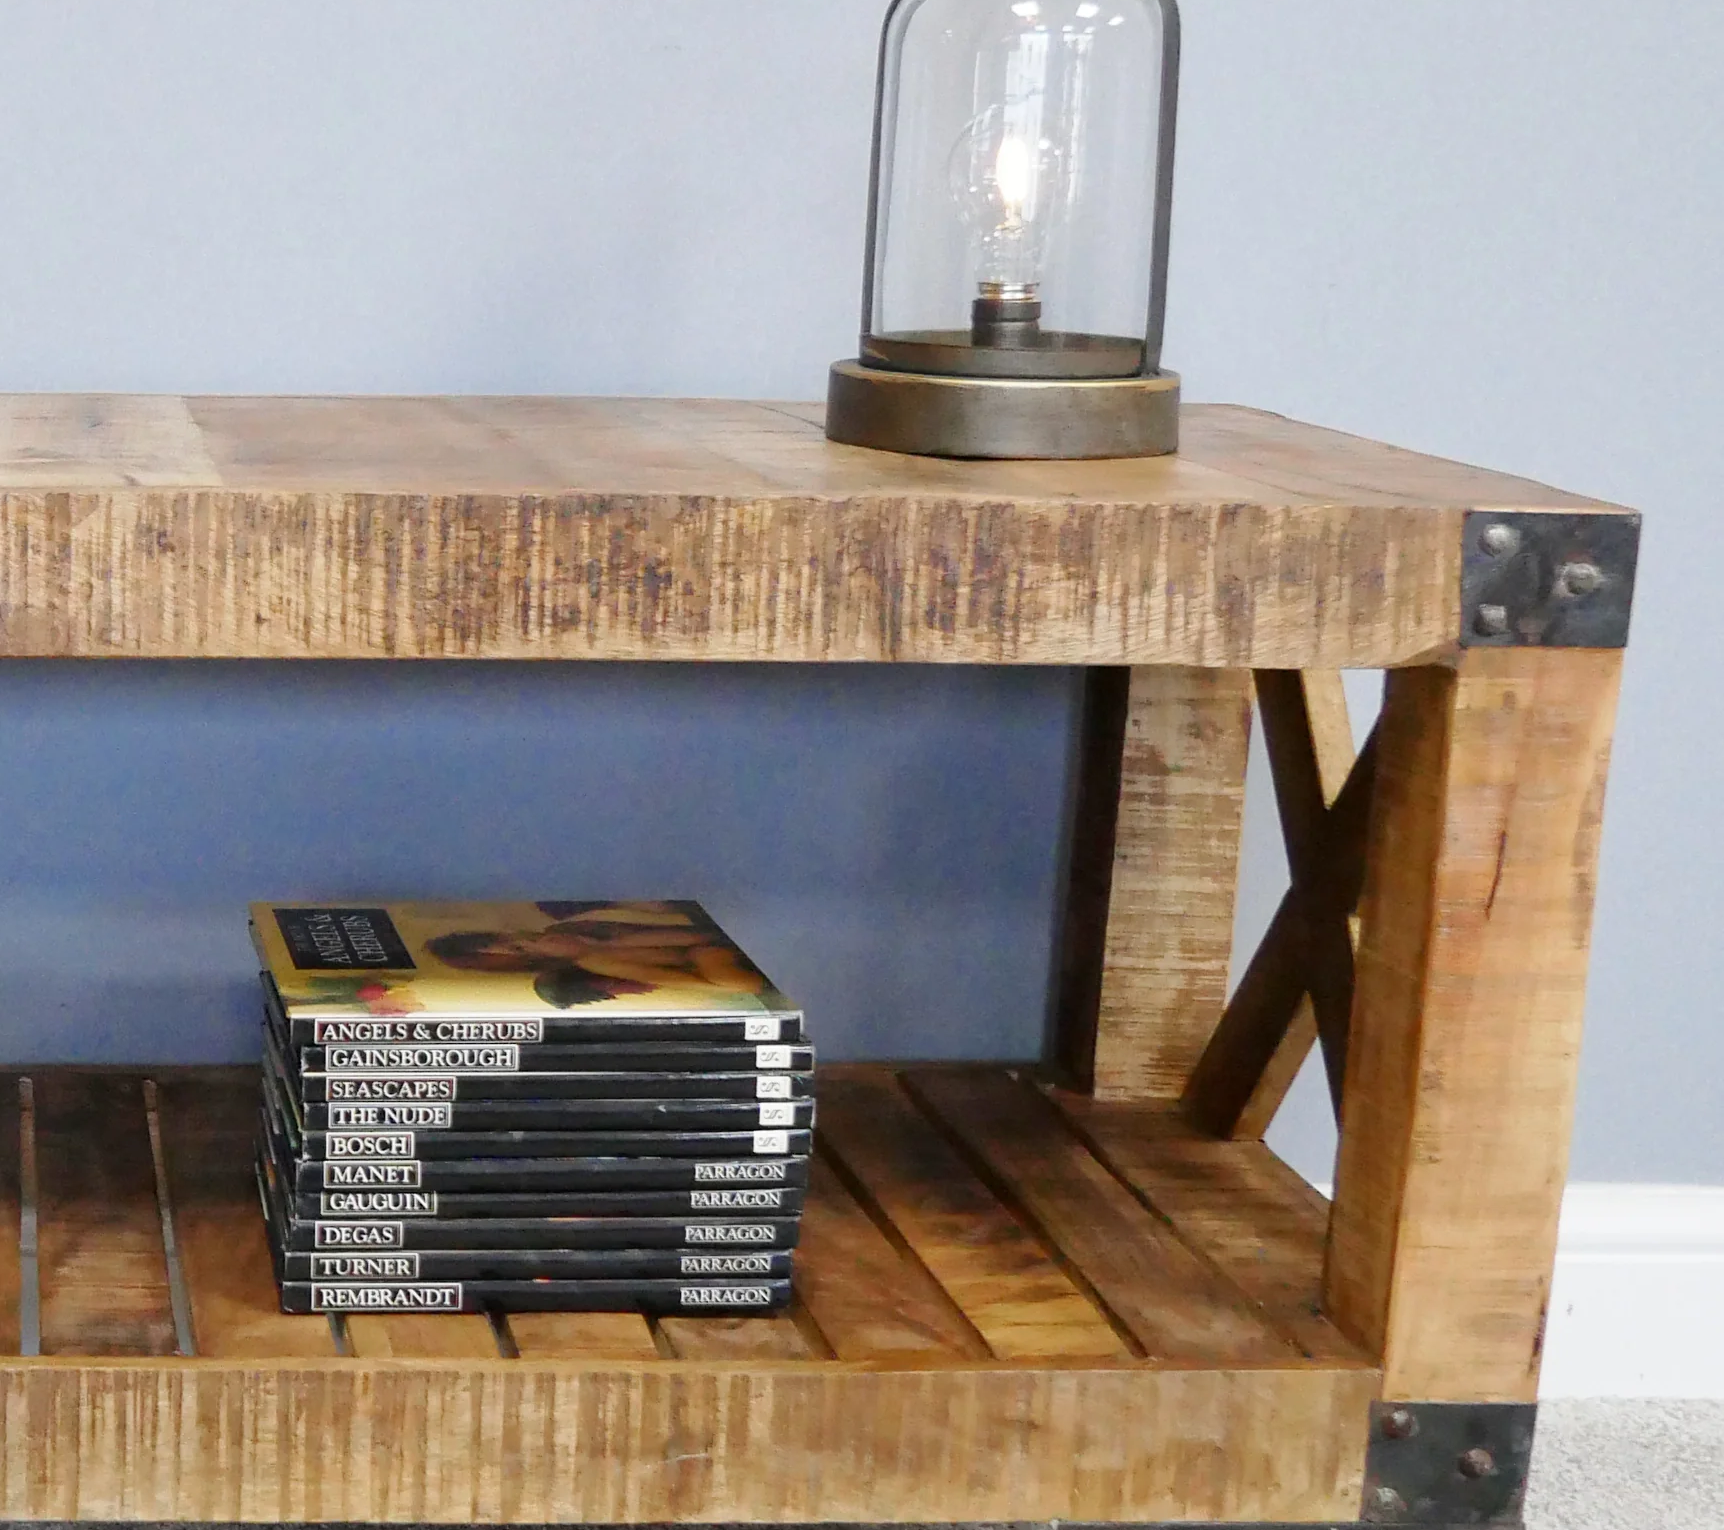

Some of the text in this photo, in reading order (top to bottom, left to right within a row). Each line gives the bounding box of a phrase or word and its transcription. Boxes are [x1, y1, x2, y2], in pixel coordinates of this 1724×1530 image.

[322, 1022, 538, 1041] ANGELS & CHERUBS
[332, 1048, 513, 1067] GAINSBOROUGH
[332, 1080, 450, 1099] SEASCAPES
[333, 1106, 445, 1125] THE NUDE
[333, 1136, 408, 1155] BOSCH
[332, 1166, 414, 1183] MANET
[695, 1164, 786, 1180] PARRAGON
[329, 1192, 430, 1211] GAUGUIN
[690, 1191, 781, 1206] PARRAGON
[324, 1226, 394, 1244] DEGAS
[685, 1226, 775, 1241] PARRAGON
[319, 1258, 411, 1276] TURNER
[680, 1256, 771, 1272] PARRAGON
[320, 1287, 456, 1307] REMBRANDT
[679, 1287, 771, 1303] PARRAGON
